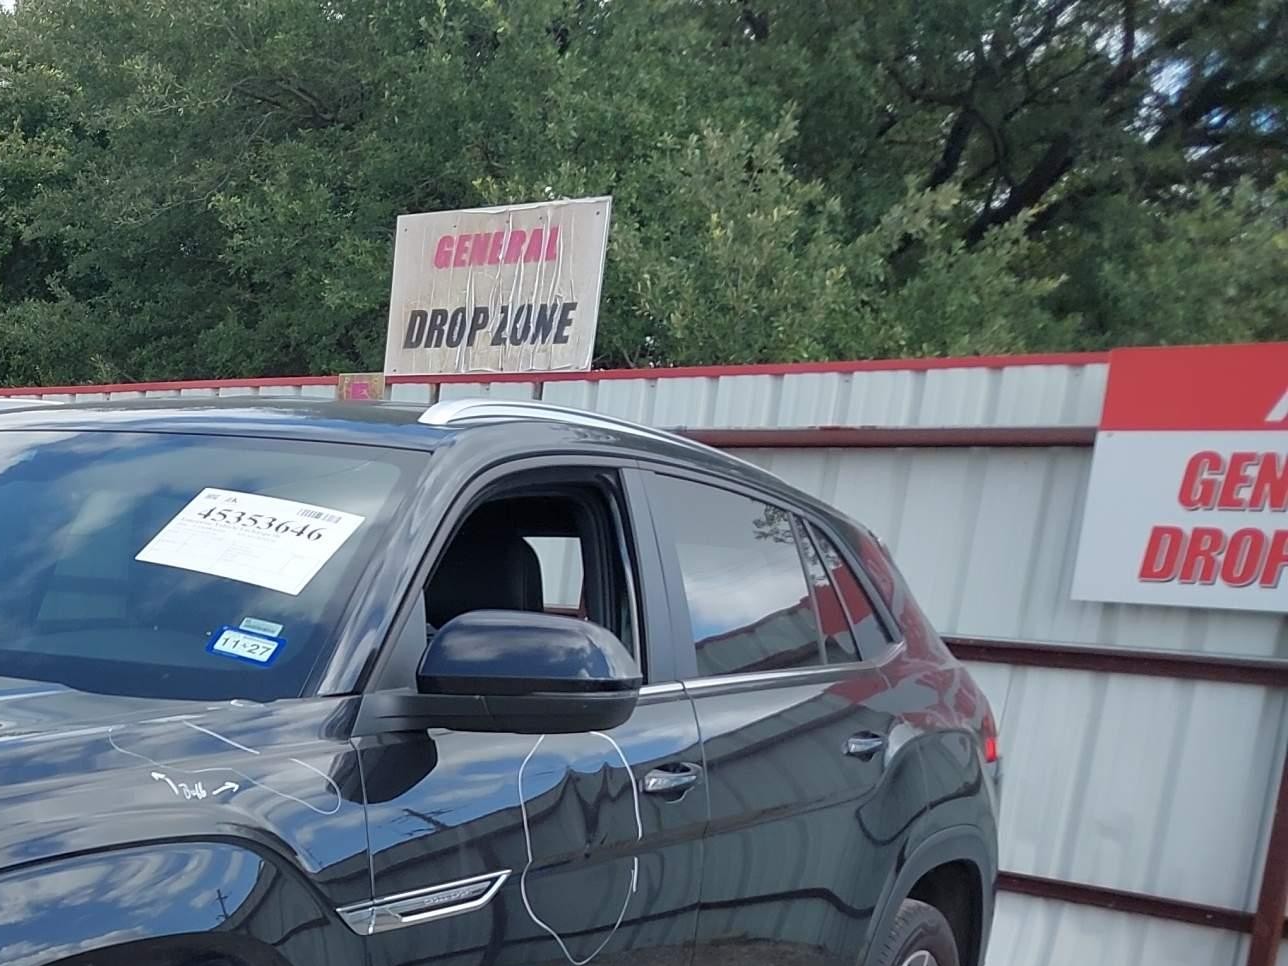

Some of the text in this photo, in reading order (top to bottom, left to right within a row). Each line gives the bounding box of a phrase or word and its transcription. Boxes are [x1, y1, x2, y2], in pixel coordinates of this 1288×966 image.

[434, 228, 560, 269] GENERAL
[403, 302, 578, 349] DROP ZONE
[197, 507, 326, 540] 45353646
